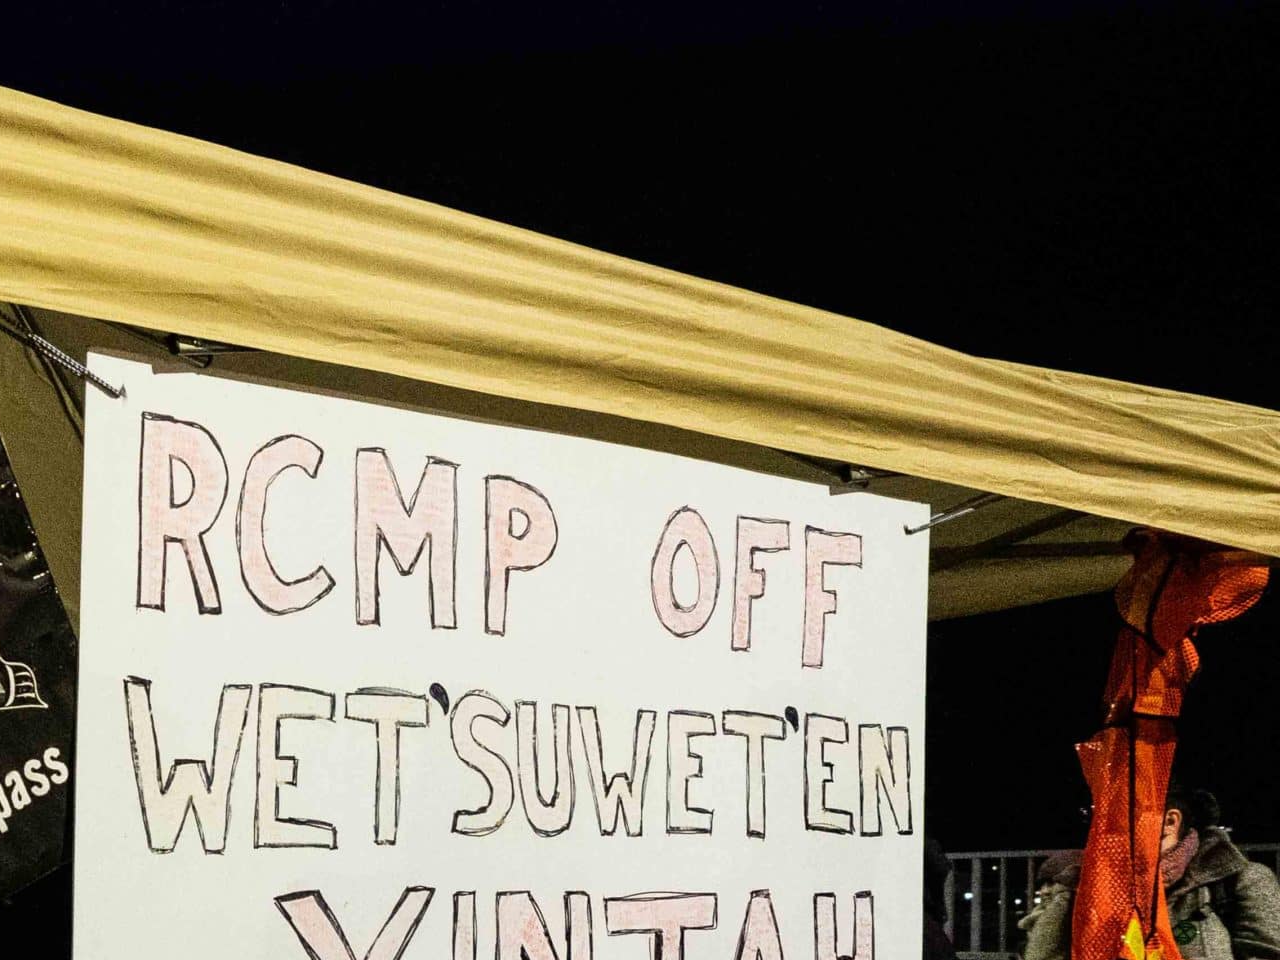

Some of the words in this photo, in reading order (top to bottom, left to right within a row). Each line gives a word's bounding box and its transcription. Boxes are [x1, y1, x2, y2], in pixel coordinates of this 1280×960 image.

[135, 411, 560, 636] RCMP
[650, 505, 864, 669] OFF
[123, 675, 914, 856] WET'SUWET'EN
